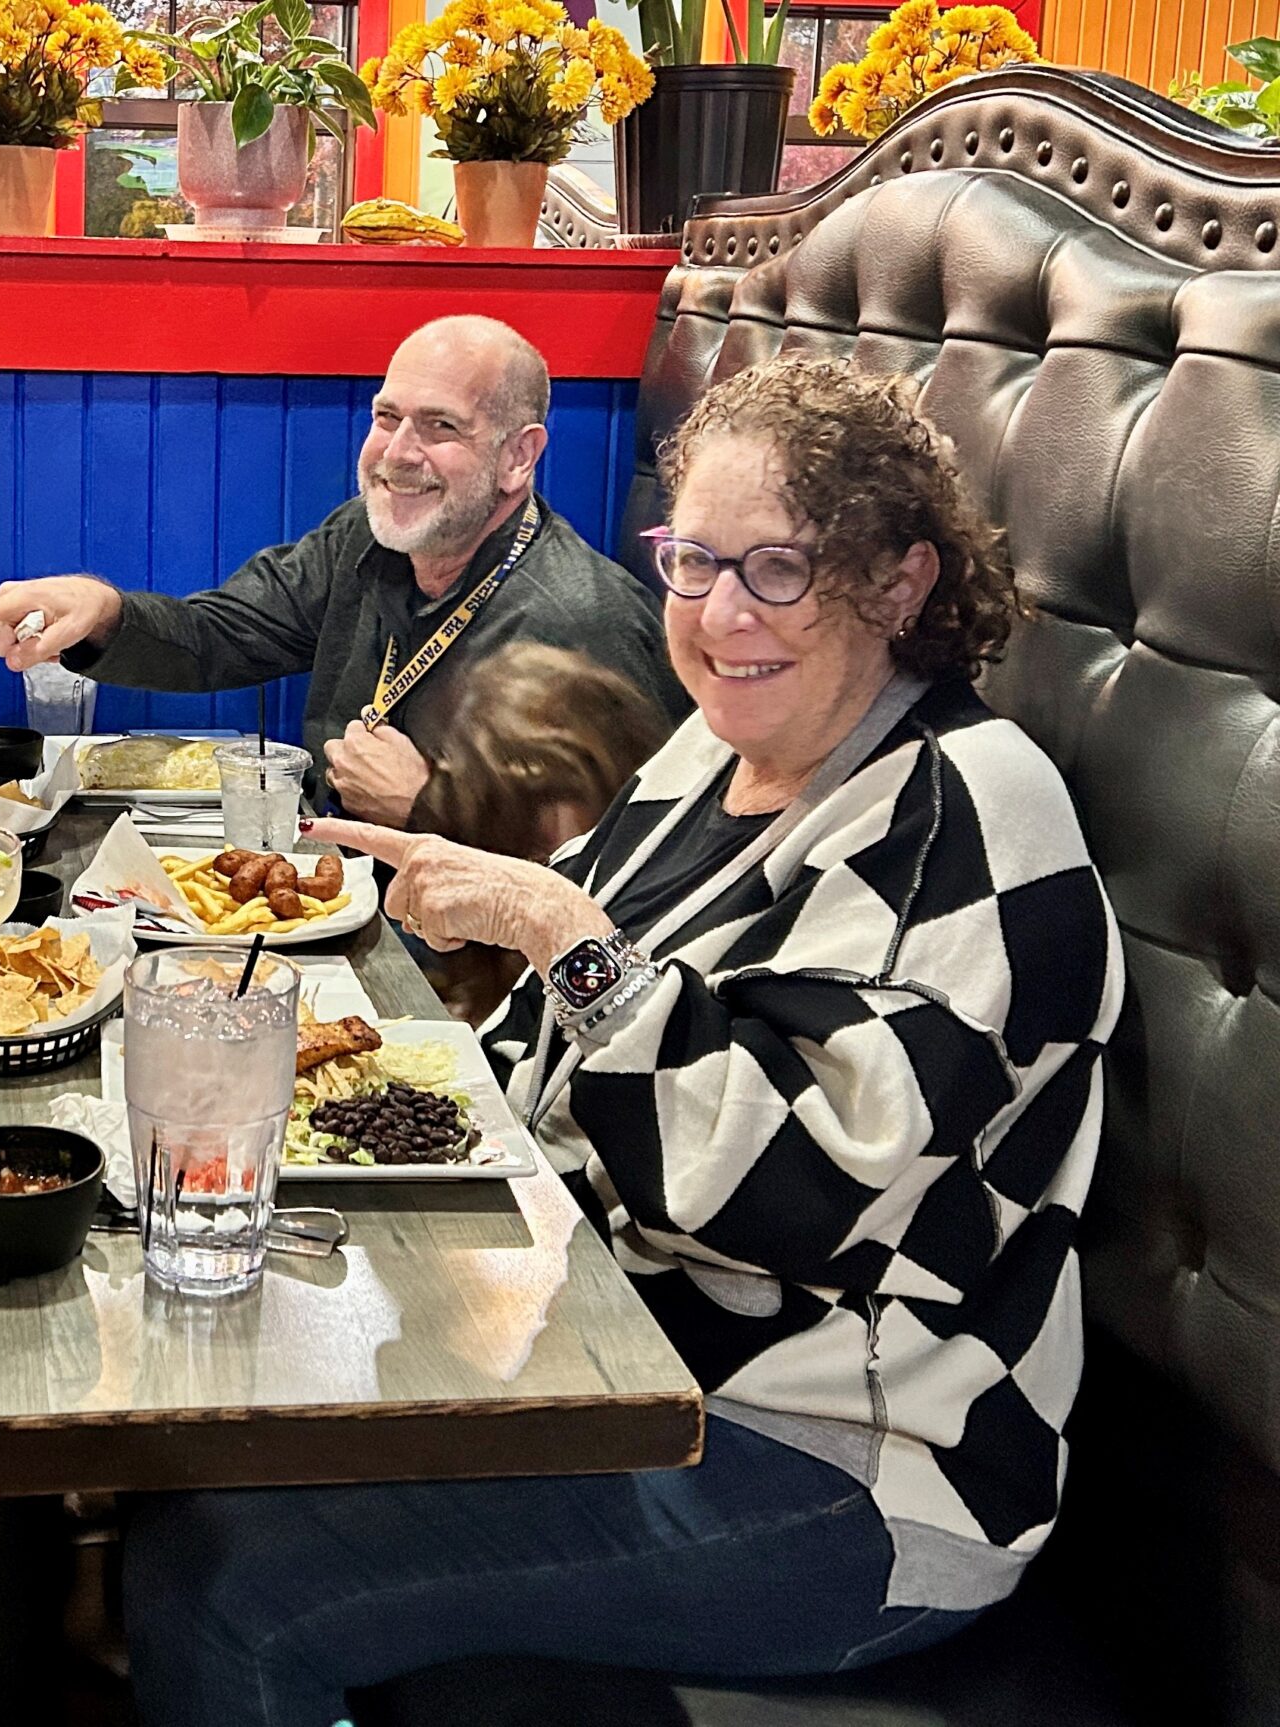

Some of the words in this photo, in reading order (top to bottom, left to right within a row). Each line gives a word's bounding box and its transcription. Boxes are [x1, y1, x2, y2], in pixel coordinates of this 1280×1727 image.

[517, 525, 535, 542] TO
[441, 615, 467, 638] Pitt
[381, 639, 443, 707] PANTHERS
